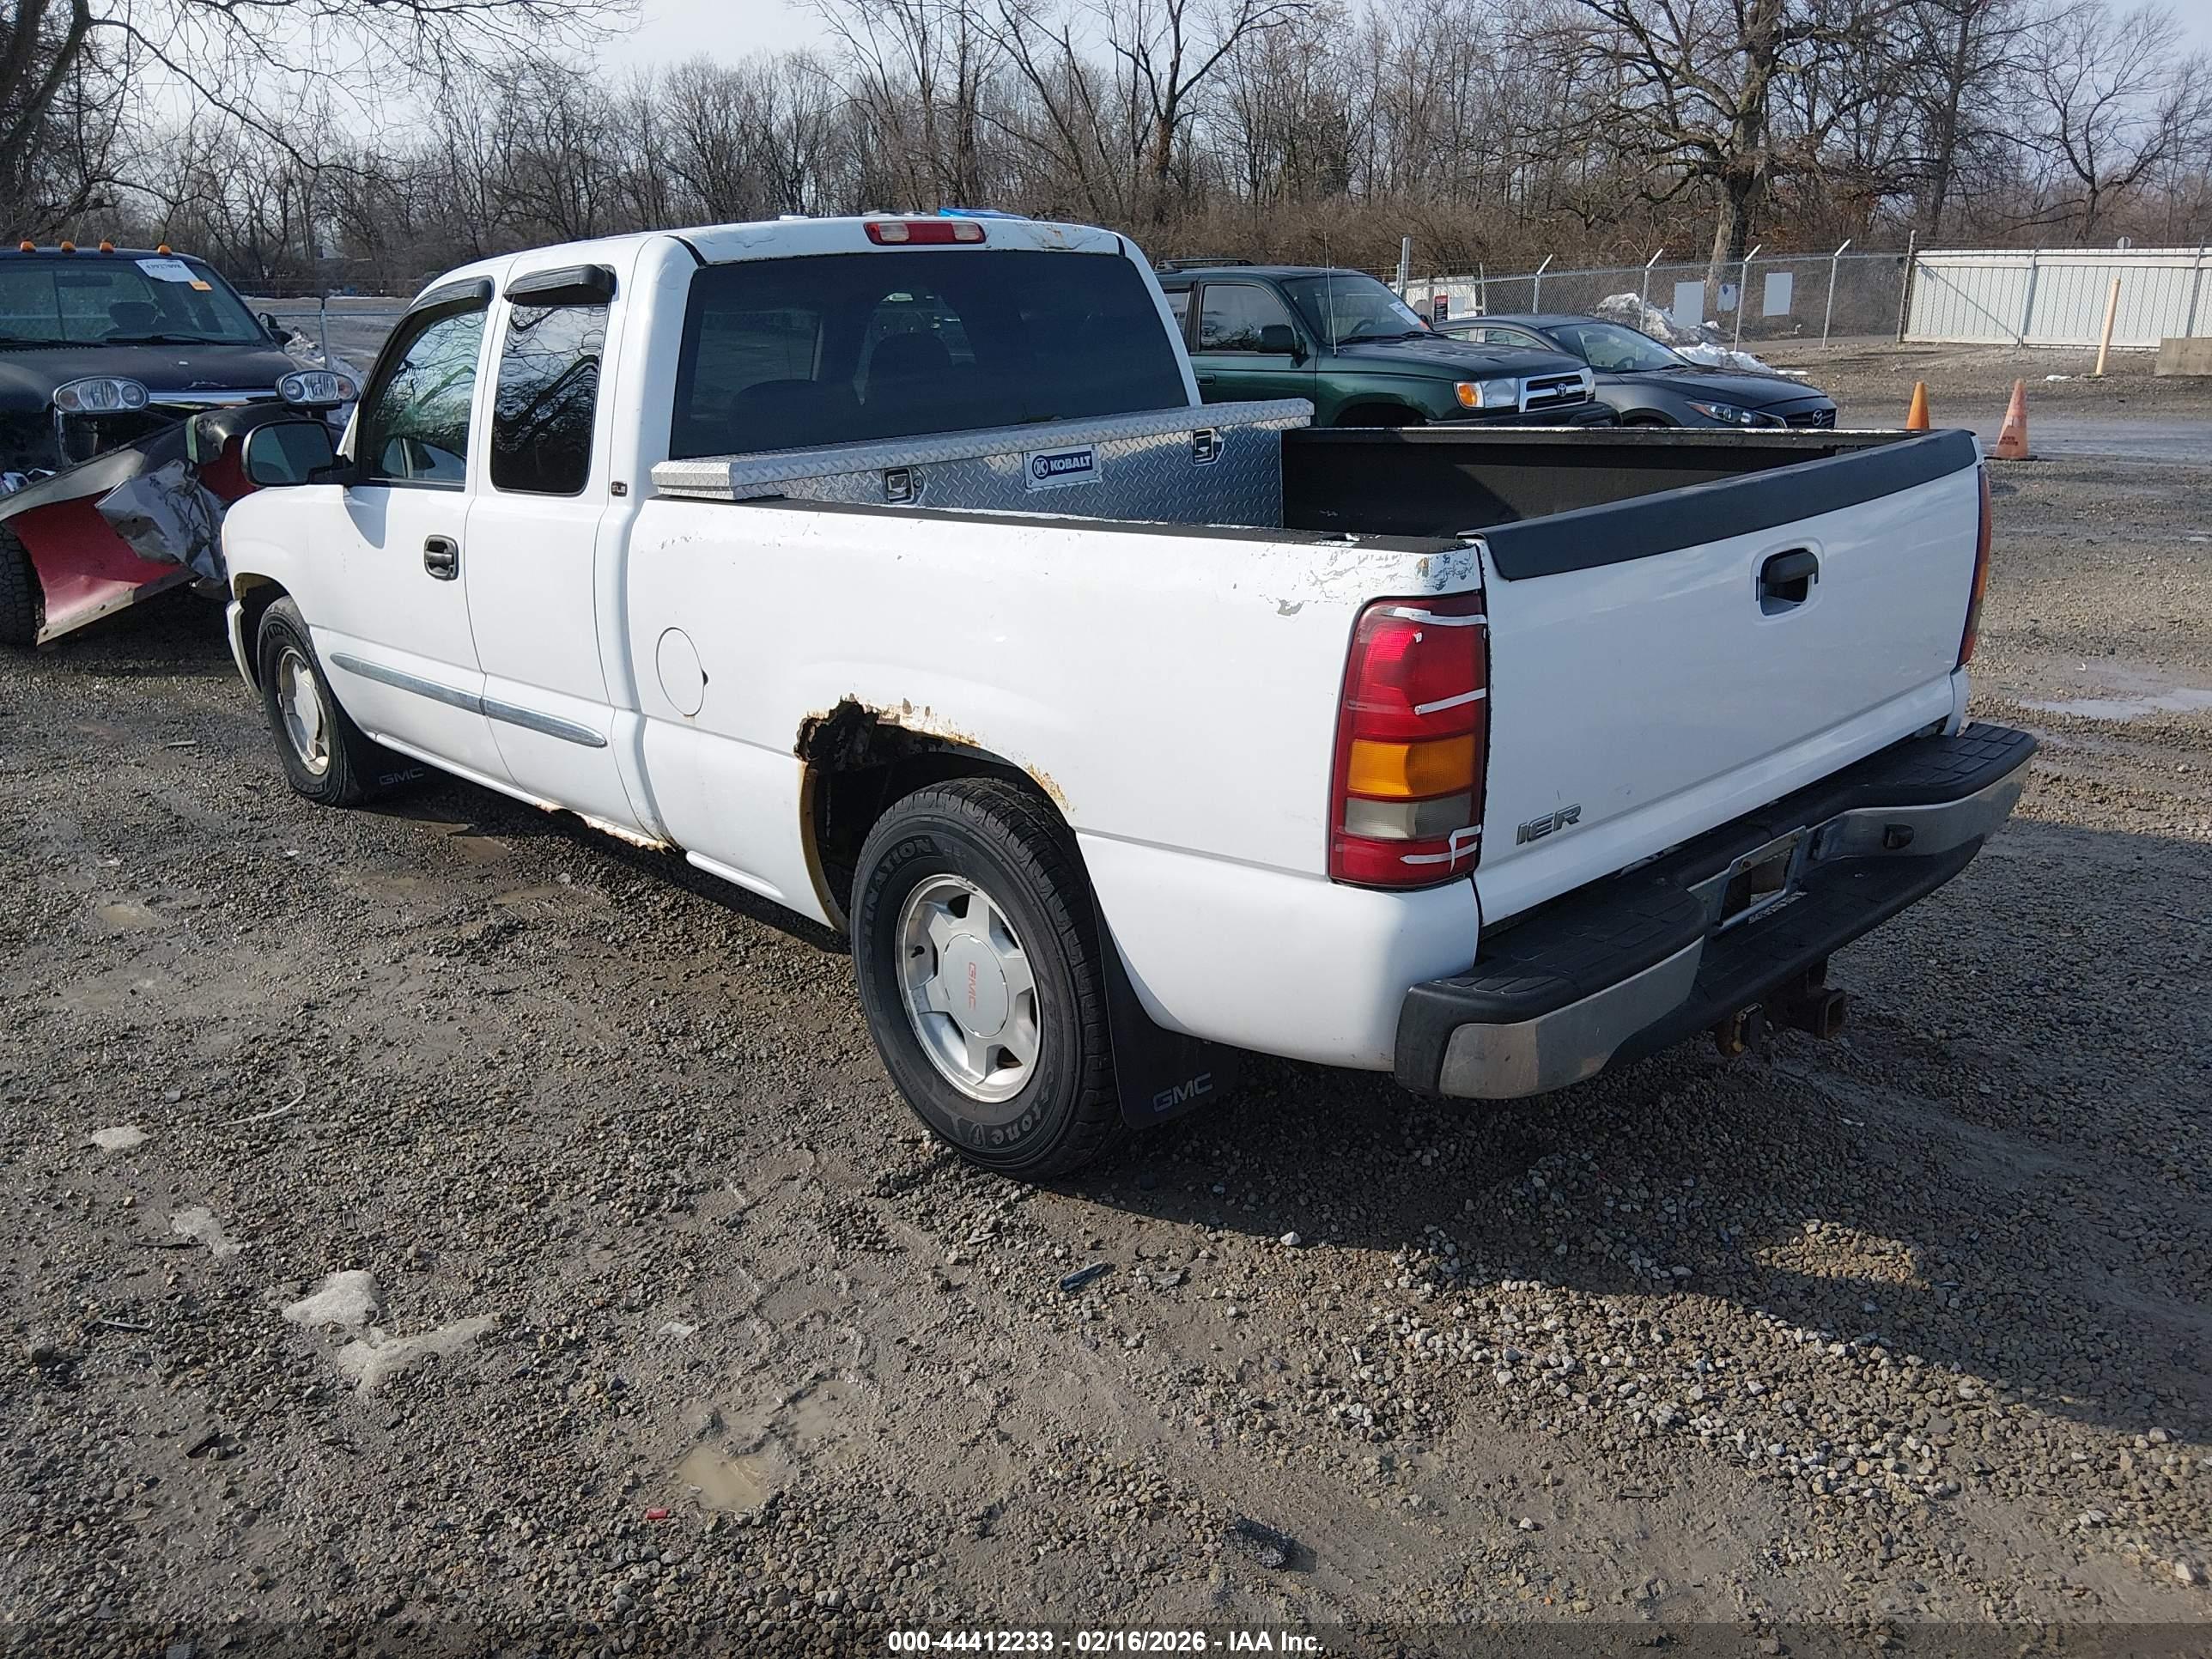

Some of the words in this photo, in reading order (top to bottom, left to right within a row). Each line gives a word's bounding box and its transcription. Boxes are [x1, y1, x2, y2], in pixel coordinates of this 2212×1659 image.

[1049, 455, 1091, 472] KOBALT
[378, 767, 425, 787] GMC
[1516, 803, 1582, 846] IER
[968, 961, 977, 1011] GMC
[1152, 1071, 1214, 1113] GMC
